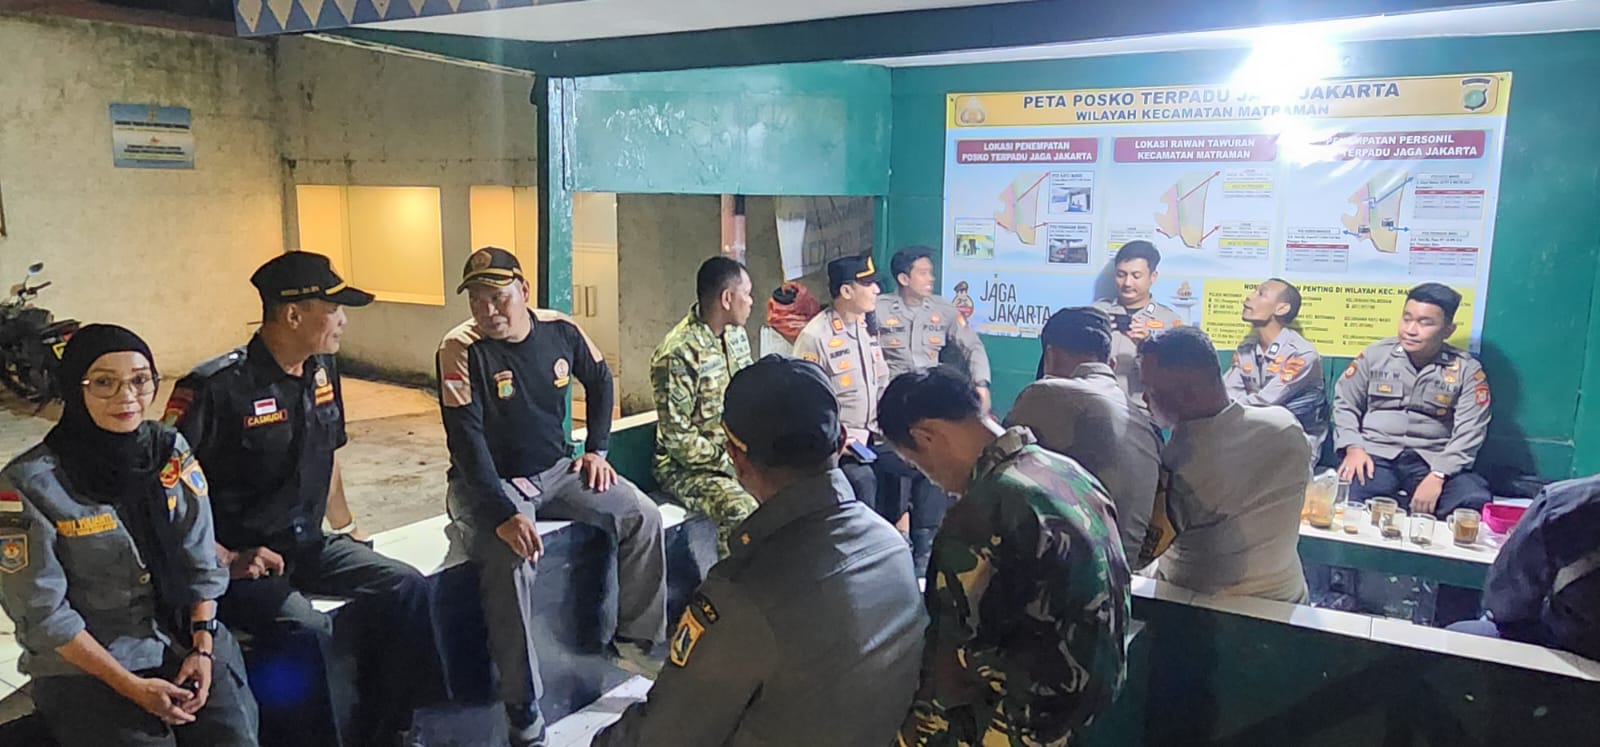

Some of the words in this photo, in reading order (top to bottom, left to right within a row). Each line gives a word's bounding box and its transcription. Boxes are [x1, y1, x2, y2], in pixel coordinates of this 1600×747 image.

[1023, 95, 1067, 109] PETA
[1073, 92, 1135, 107] POSKO
[1141, 89, 1230, 106] TERPADU
[1298, 82, 1400, 101] JAKARTA
[1076, 109, 1137, 122] WILAYAH
[1142, 106, 1233, 120] KECAMATAN
[1135, 140, 1168, 149] LOKASI
[1171, 140, 1205, 149] RAWAN
[1208, 139, 1255, 148] TAWURAN
[1400, 135, 1455, 145] PERSONIL
[983, 142, 1013, 151] LOKASI
[1015, 142, 1070, 151] PENEMPATAN
[1393, 148, 1422, 157] JAGA
[1425, 146, 1477, 156] JAKARTA
[962, 153, 989, 162] POSKO
[991, 153, 1027, 162] TERPADU
[1030, 153, 1051, 161] JAGA
[1053, 152, 1092, 161] JAKARTA
[1138, 151, 1194, 160] KECAMATAN
[1196, 150, 1250, 159] MATRAMAN
[980, 279, 1017, 303] JAGA
[1302, 285, 1334, 293] PENTING
[1345, 286, 1376, 294] WILAYAH
[988, 303, 1053, 325] JAKARTA
